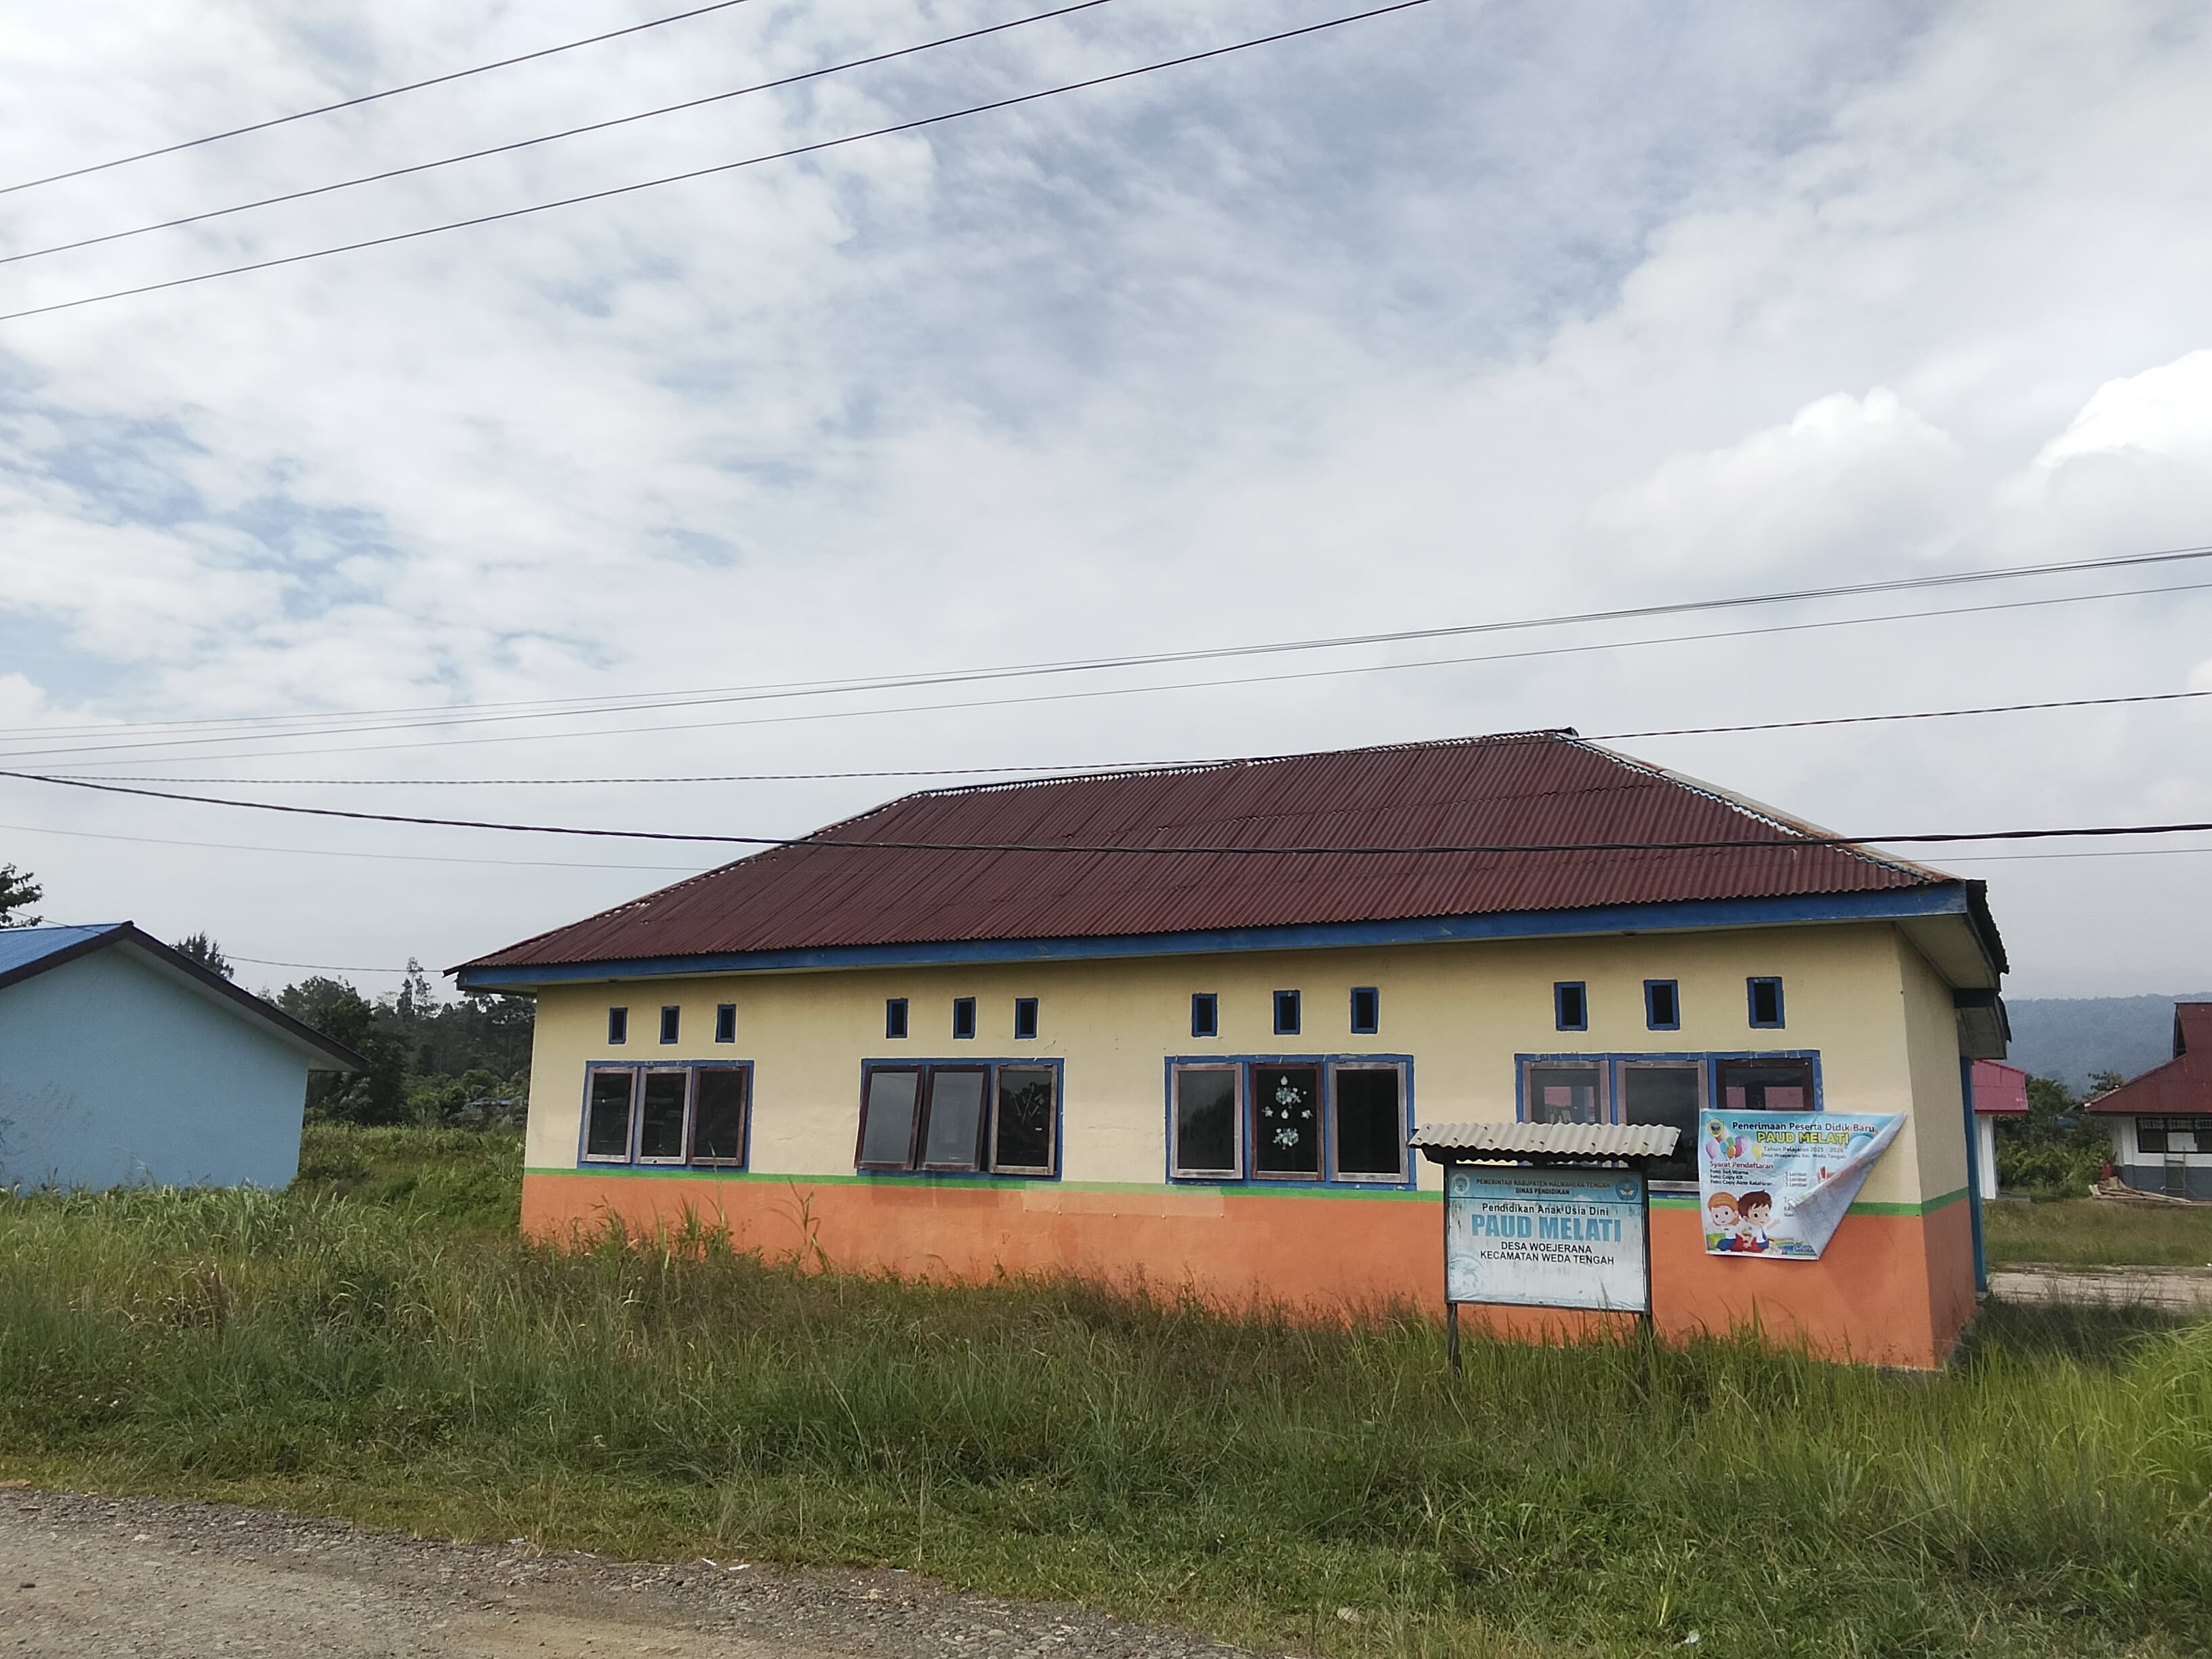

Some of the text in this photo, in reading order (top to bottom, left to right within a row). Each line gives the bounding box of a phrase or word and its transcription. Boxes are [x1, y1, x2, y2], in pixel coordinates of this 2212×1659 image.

[1732, 1122, 1875, 1132] Penerimaan Peserta Didik Baru
[1757, 1131, 1849, 1145] PAUD MELATI
[1482, 1203, 1609, 1216] Pendidikan Anak Usia Dini
[1471, 1214, 1622, 1242] PAUD MELATI
[1501, 1242, 1592, 1254] DESA WOEJERANA
[1480, 1250, 1614, 1265] KECAMATAN WEDA TENGAH
